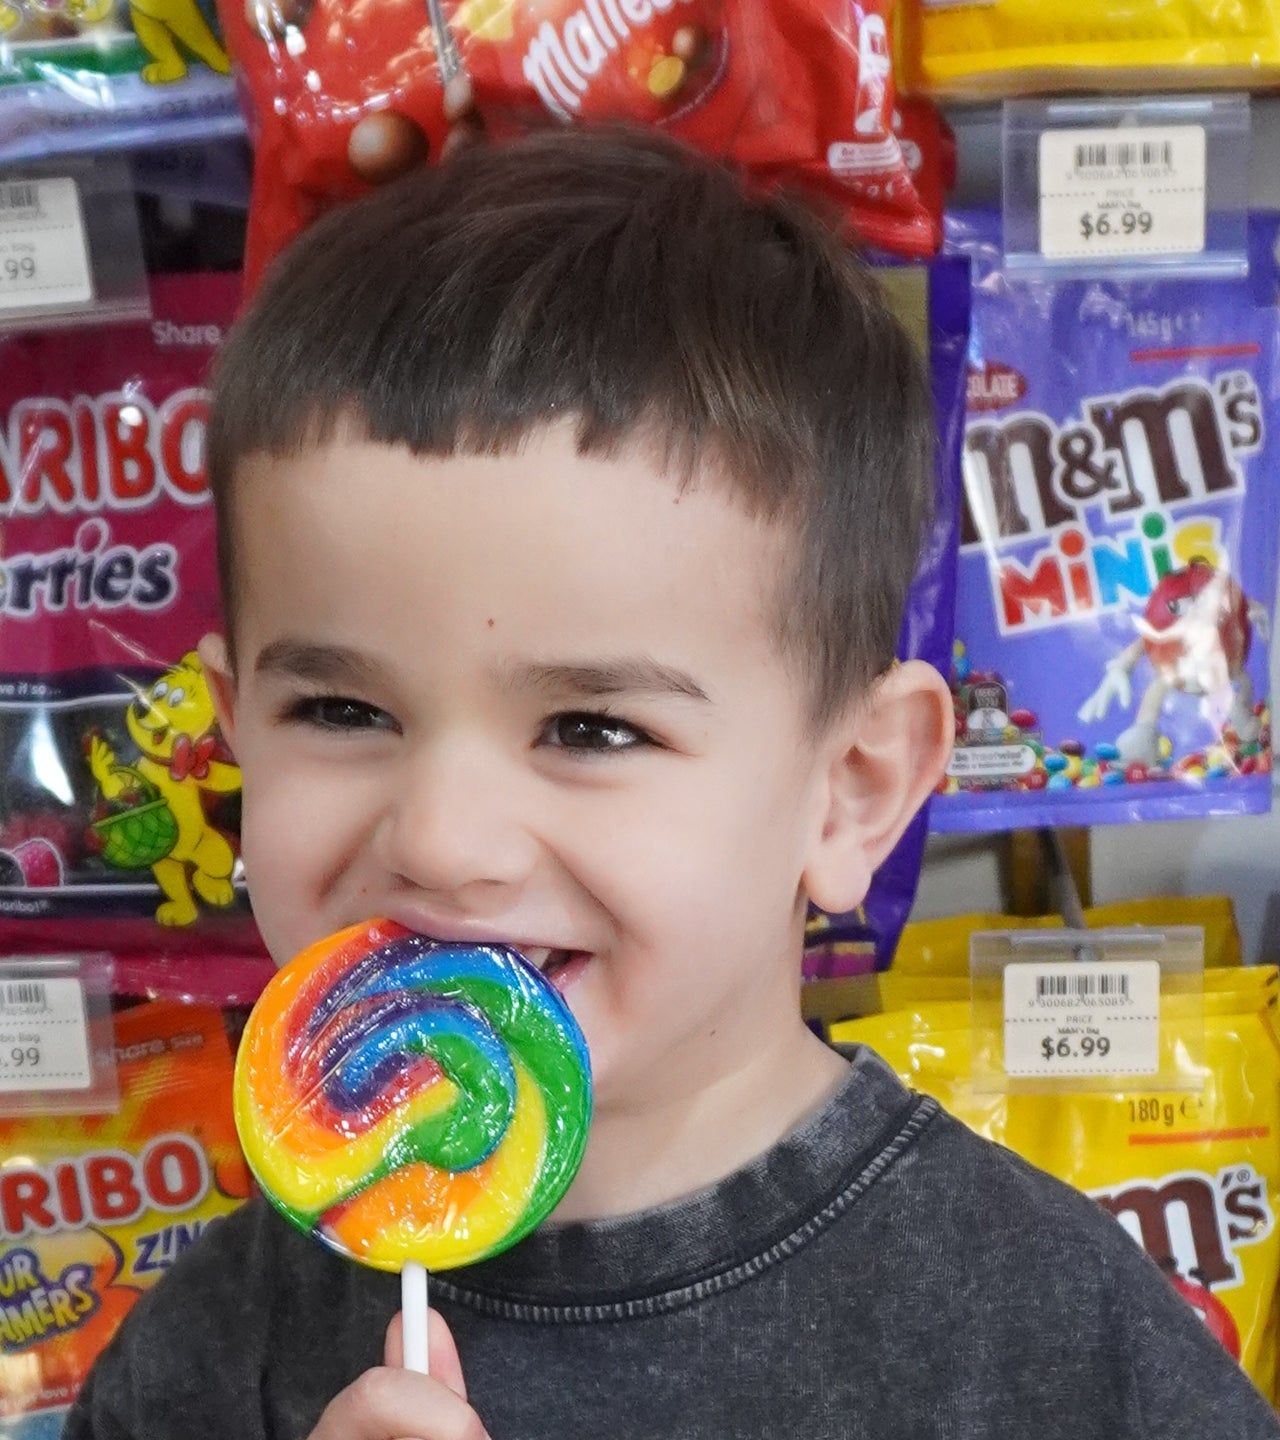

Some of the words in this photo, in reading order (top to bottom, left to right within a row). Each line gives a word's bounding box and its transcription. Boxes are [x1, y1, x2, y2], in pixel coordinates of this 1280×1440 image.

[1079, 212, 1153, 241] $6.99
[152, 318, 221, 348] Share
[1065, 1014, 1094, 1024] PRICE
[1041, 1036, 1111, 1062] $6.99
[1128, 1098, 1161, 1123] 180
[1162, 1102, 1175, 1127] g
